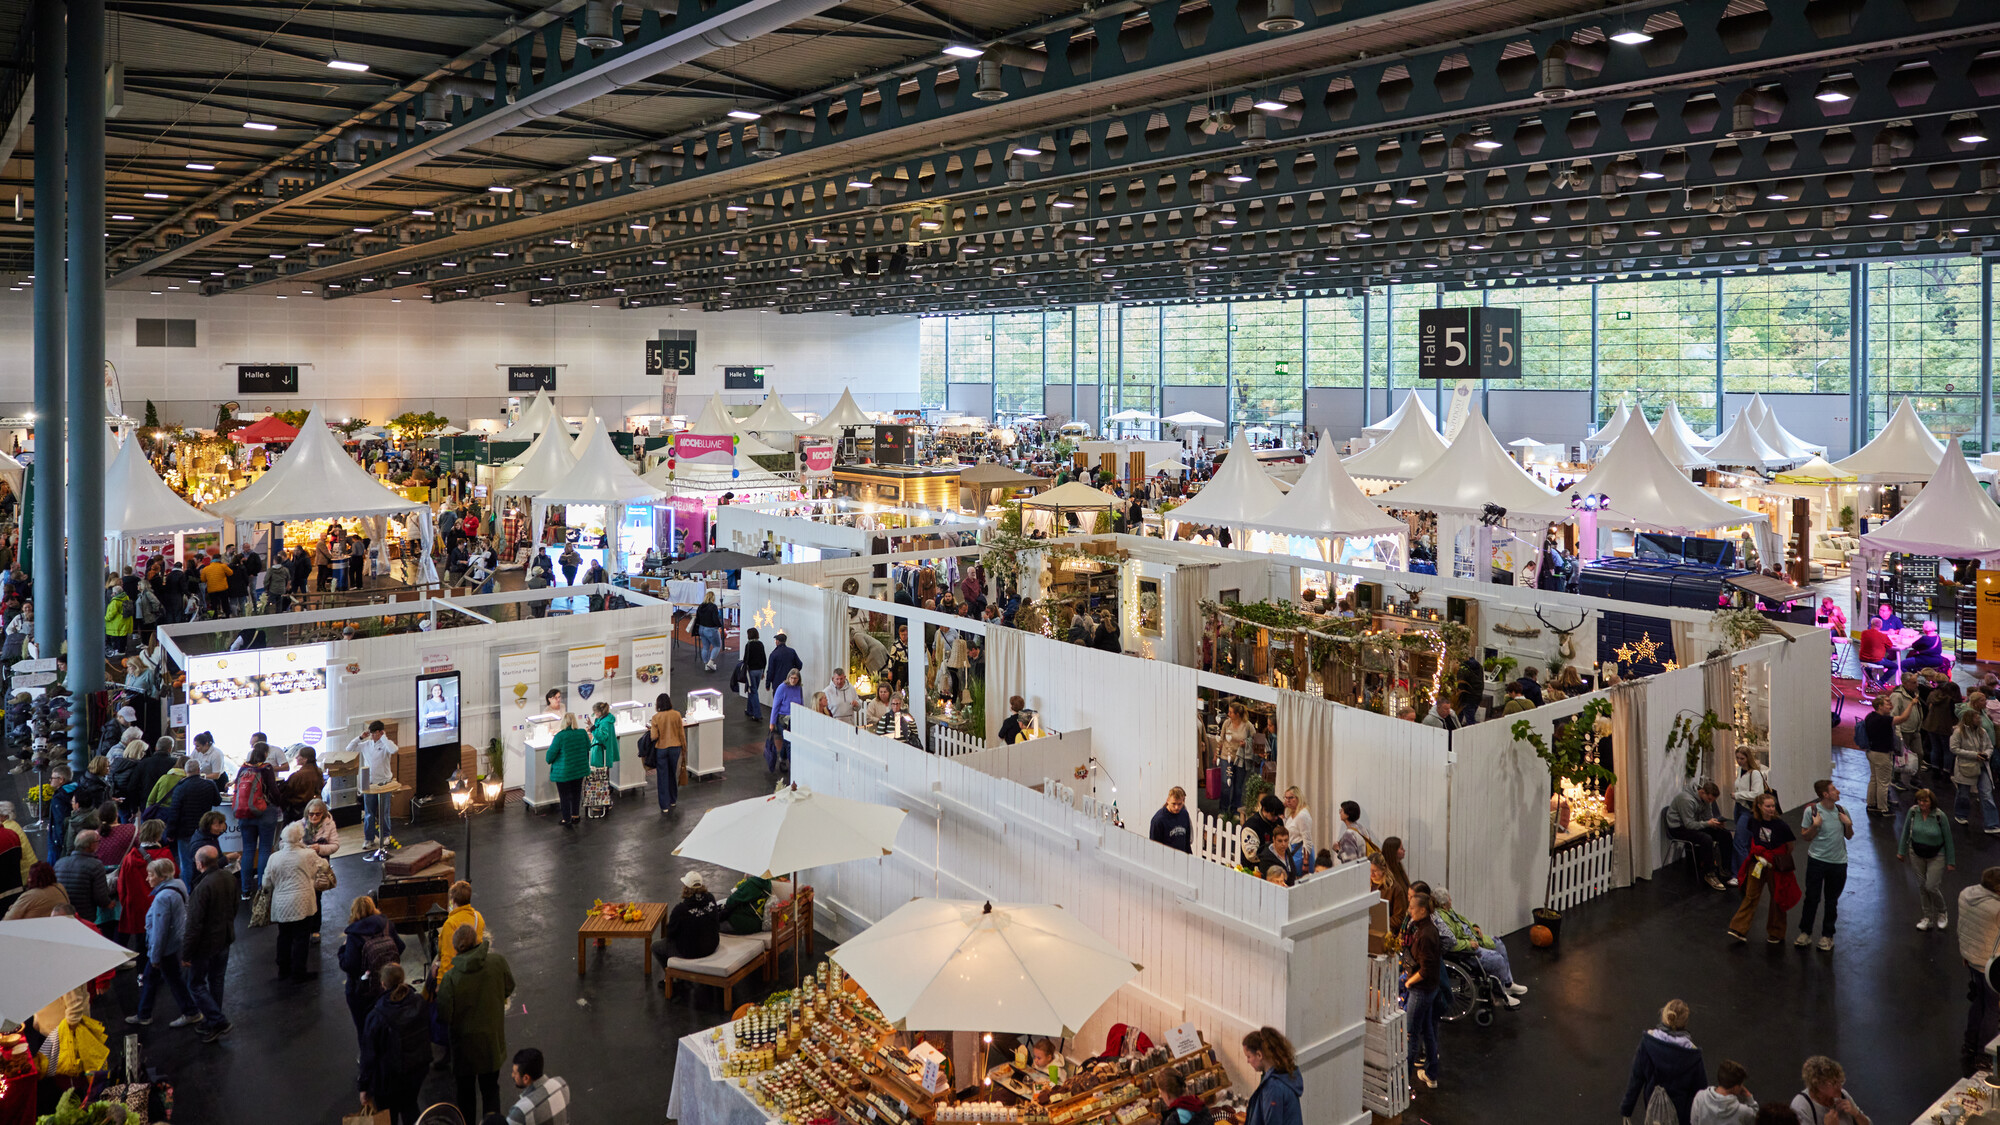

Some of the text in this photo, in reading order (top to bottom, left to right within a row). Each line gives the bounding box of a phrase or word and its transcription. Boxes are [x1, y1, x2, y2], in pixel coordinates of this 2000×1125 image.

[1422, 324, 1467, 367] Halle 5
[1482, 323, 1514, 367] Halle 5
[654, 349, 662, 369] 5
[678, 349, 690, 369] 5
[208, 687, 254, 700] SNACKEN
[270, 679, 321, 693] GANZ FRISCH
